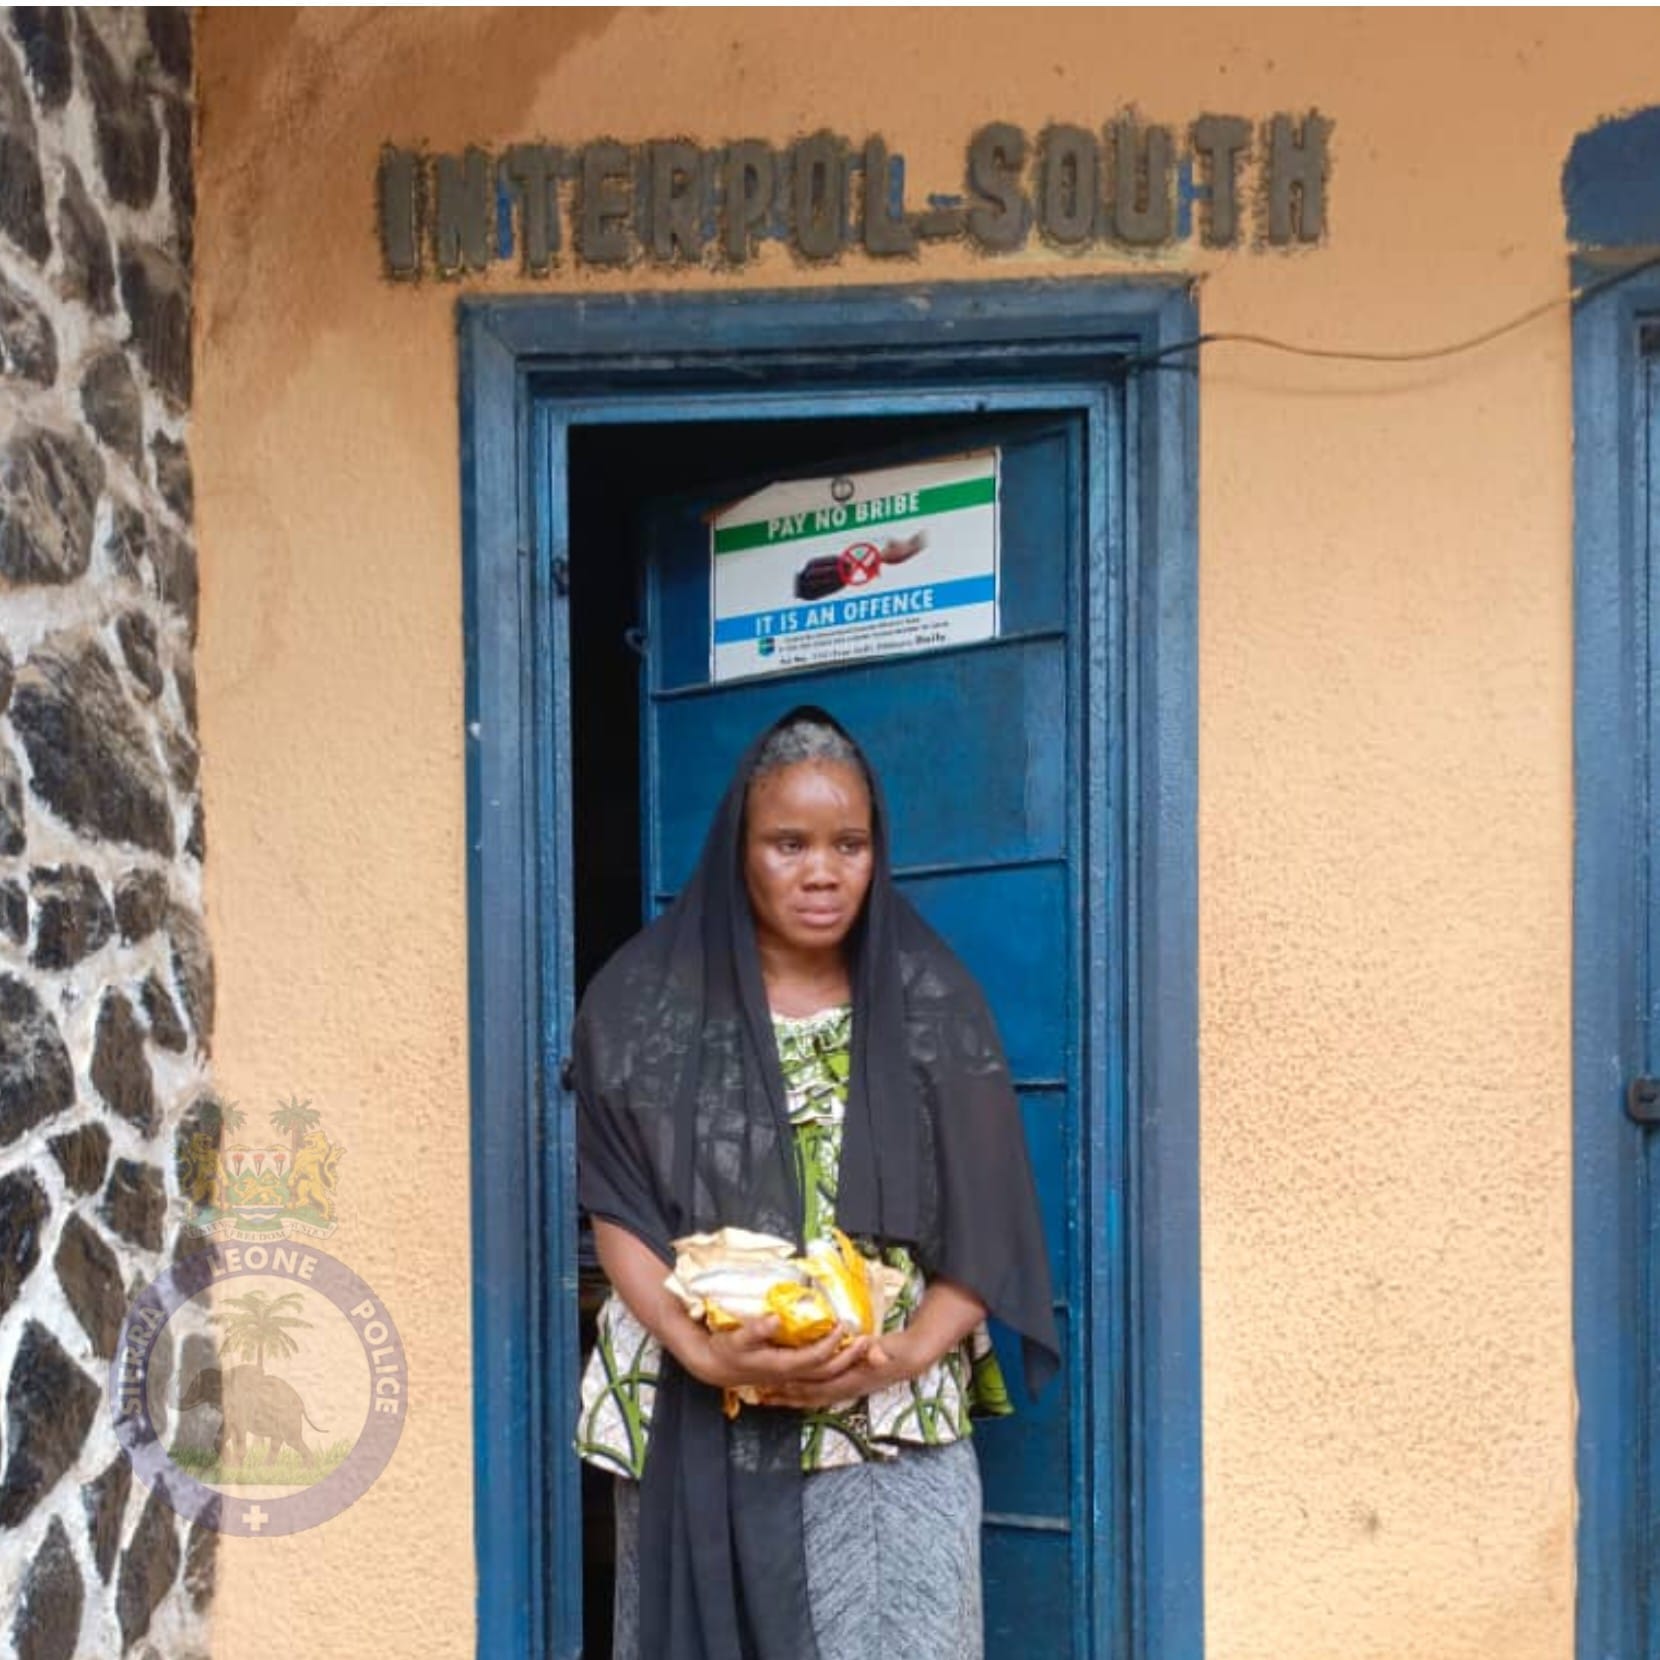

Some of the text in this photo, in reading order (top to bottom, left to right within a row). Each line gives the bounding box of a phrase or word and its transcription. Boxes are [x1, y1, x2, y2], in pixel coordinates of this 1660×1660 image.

[378, 109, 1333, 279] INTERPOL-SOUTH
[767, 493, 921, 540] PAY NO BRIBE
[756, 615, 774, 634] IT
[780, 612, 798, 631] IS
[806, 606, 835, 627] AN
[843, 588, 934, 619] OFFENCE
